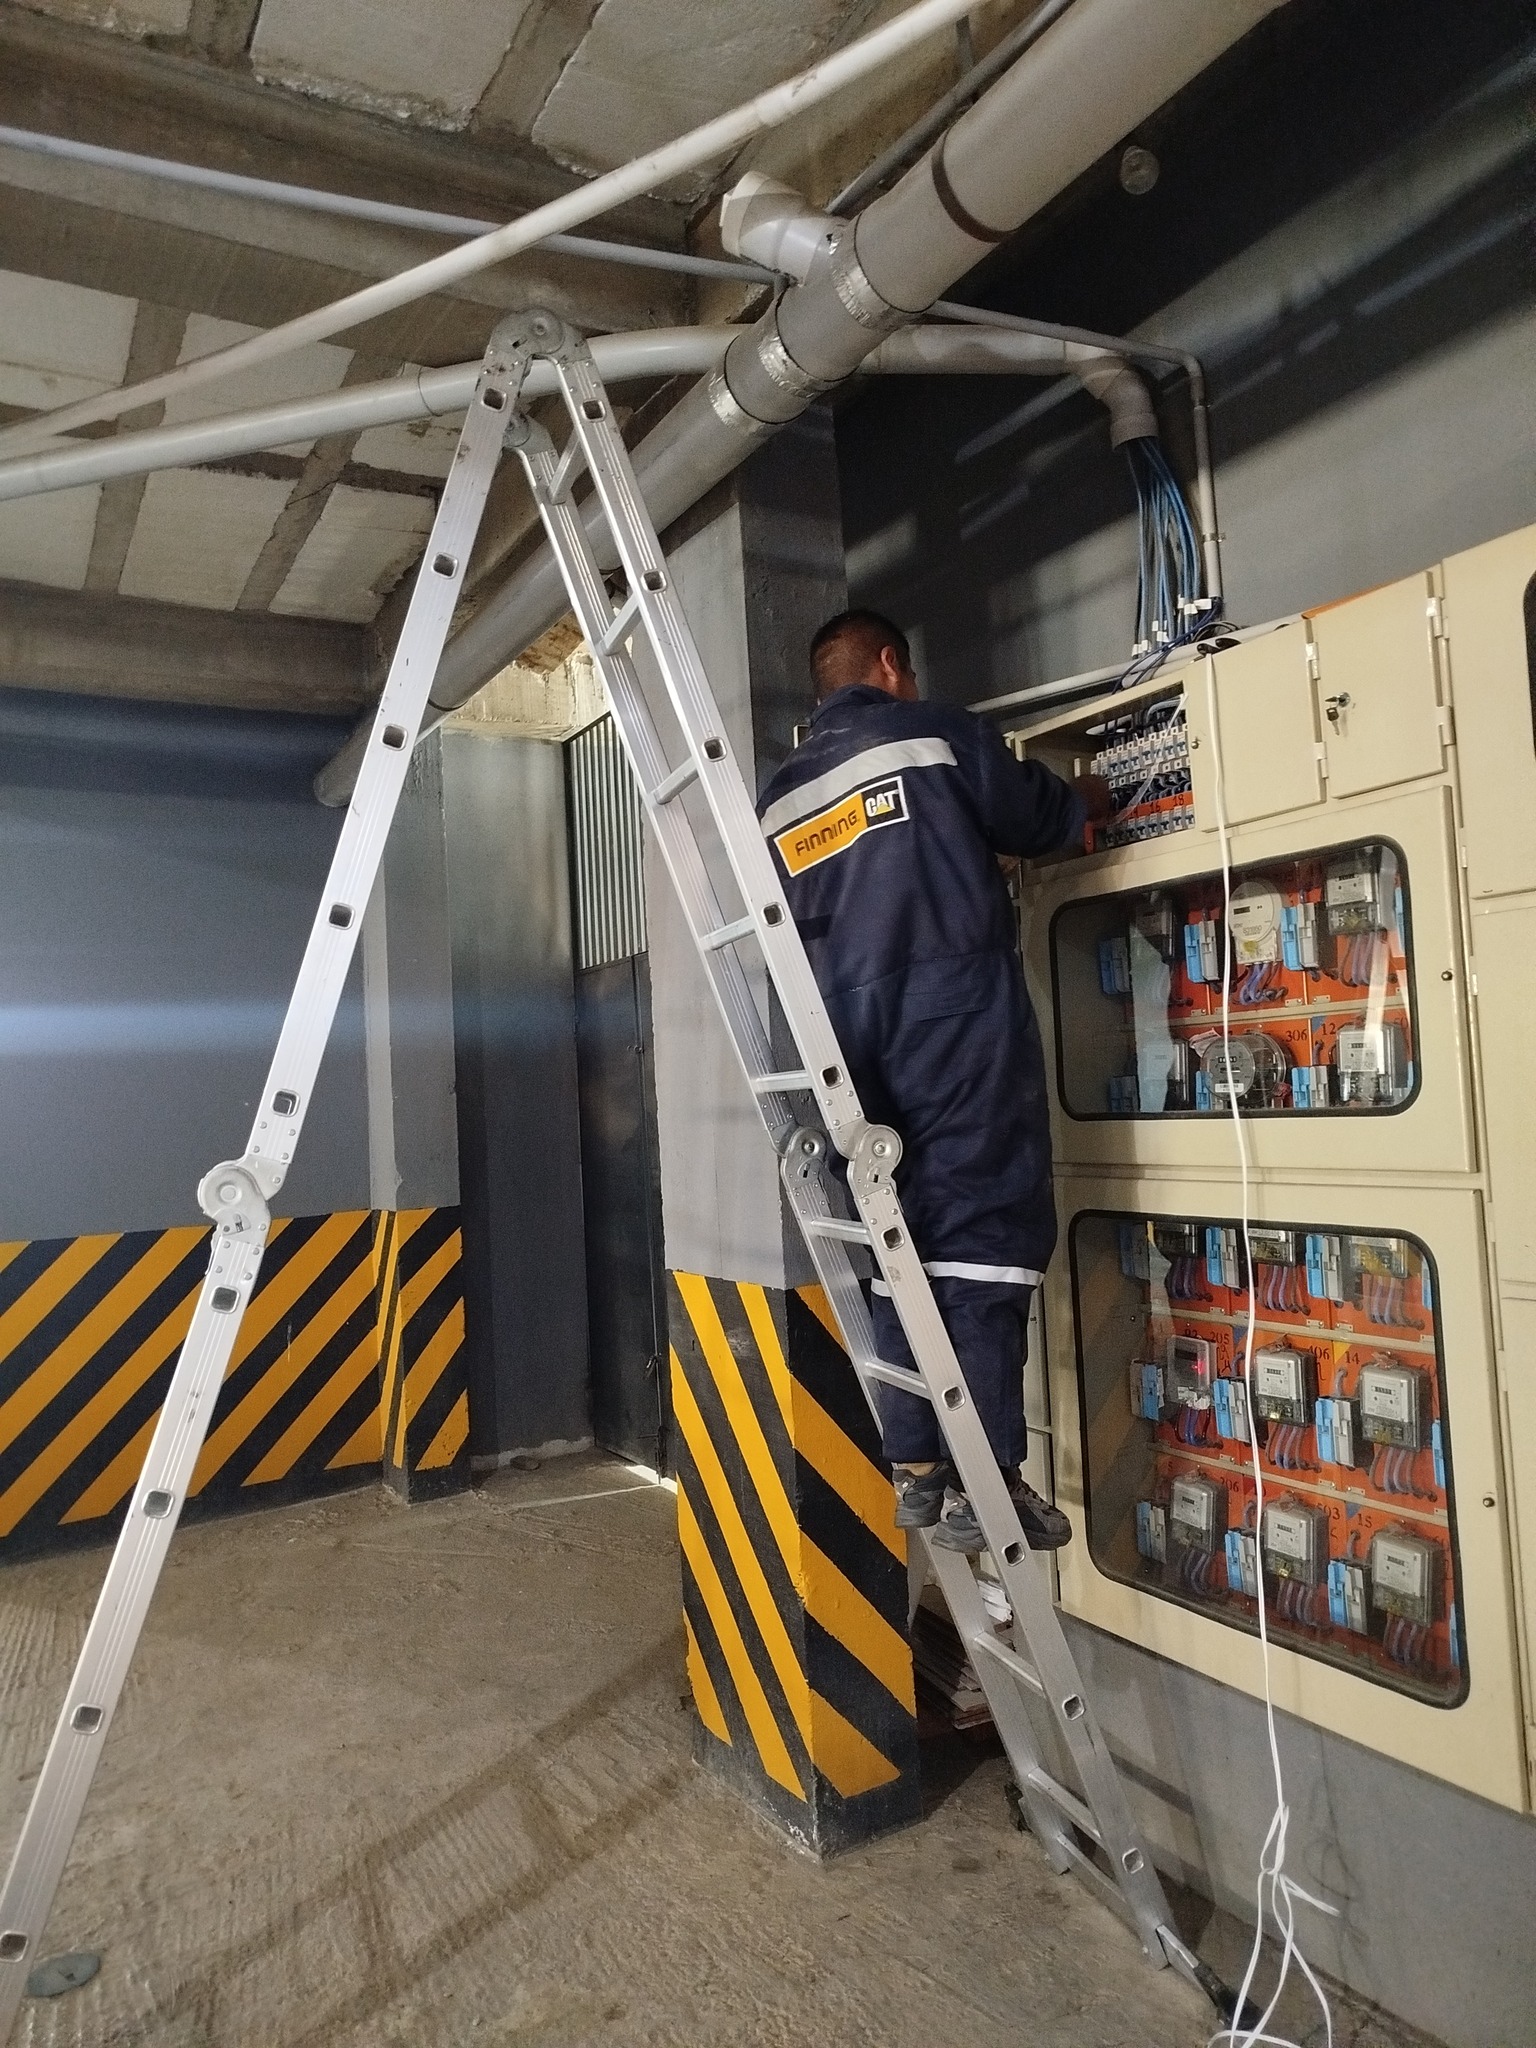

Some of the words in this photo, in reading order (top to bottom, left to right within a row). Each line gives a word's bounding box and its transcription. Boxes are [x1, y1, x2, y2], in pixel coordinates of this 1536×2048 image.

[1172, 793, 1185, 807] 18
[794, 809, 860, 857] FINNING
[865, 790, 899, 817] CAT
[1321, 1023, 1336, 1036] 12
[1345, 1350, 1360, 1365] 14
[1357, 1513, 1373, 1529] 15
